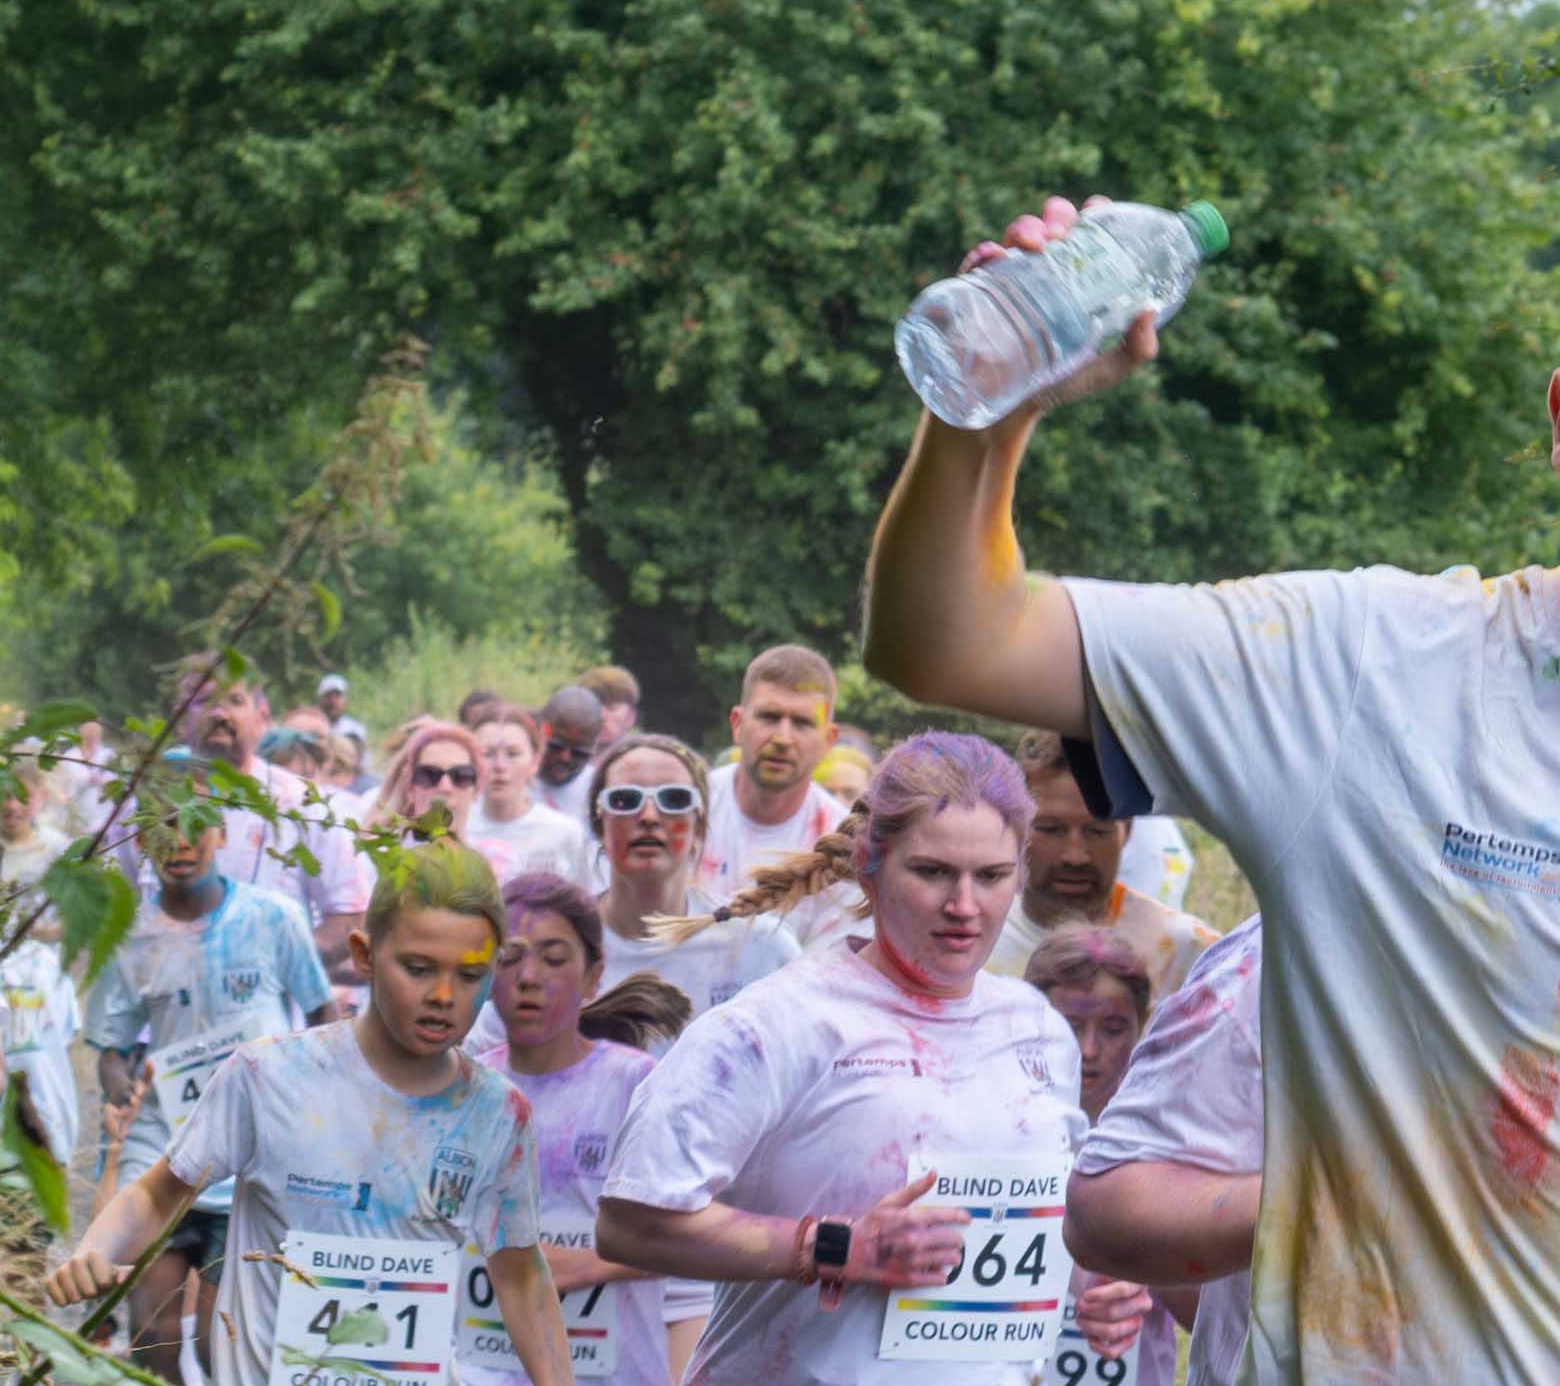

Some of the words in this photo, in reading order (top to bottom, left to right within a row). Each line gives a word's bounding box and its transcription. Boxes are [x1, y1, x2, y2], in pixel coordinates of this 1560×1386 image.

[1442, 839, 1540, 877] Network
[936, 1176, 1003, 1197] BLIND
[1009, 1176, 1059, 1197] DAVE
[540, 1231, 591, 1248] DAVE
[312, 1250, 376, 1272] BLIND
[380, 1255, 435, 1274] DAVE
[306, 1299, 420, 1350] 41
[905, 1320, 999, 1342] COLOUR
[1003, 1322, 1046, 1342] RUN
